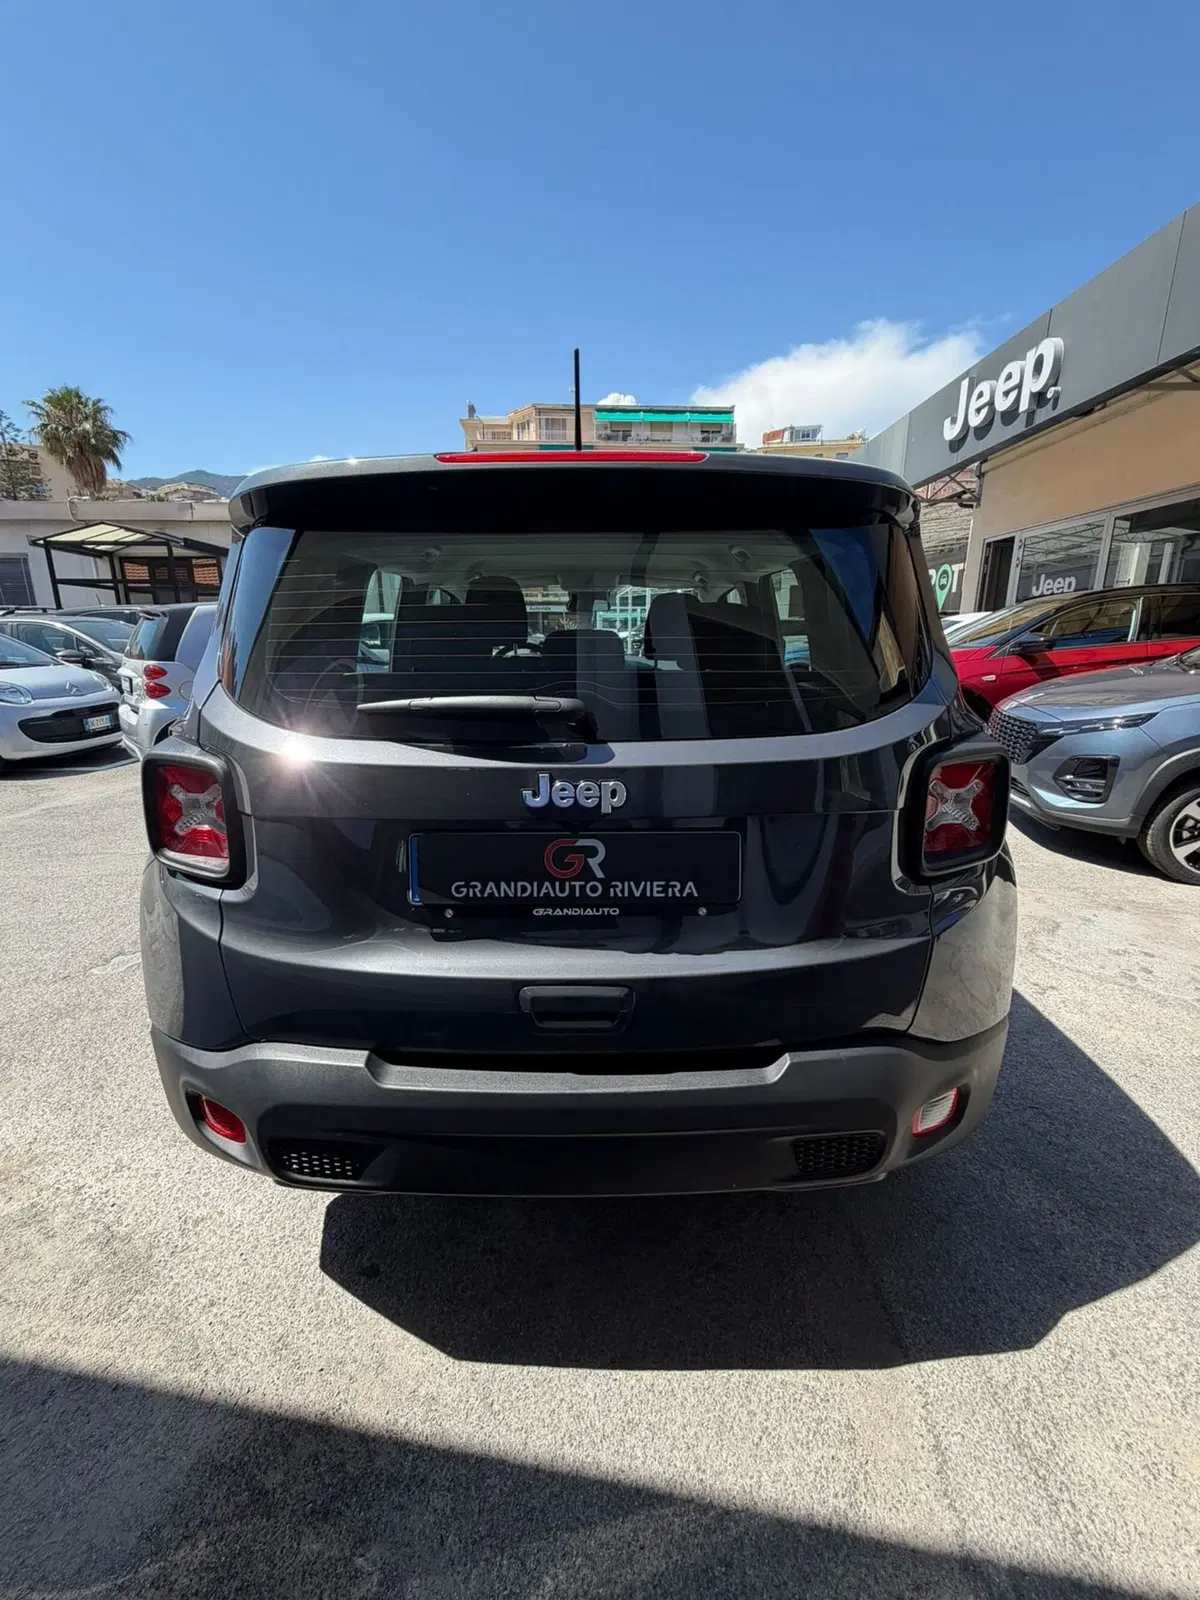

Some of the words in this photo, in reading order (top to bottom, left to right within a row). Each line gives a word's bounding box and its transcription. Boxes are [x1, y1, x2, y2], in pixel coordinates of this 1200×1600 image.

[943, 338, 1063, 441] Jeep
[1032, 573, 1076, 597] Jeep
[521, 772, 627, 814] Jeep
[544, 839, 606, 879] GR
[451, 881, 603, 898] GRANDIAUTO
[610, 881, 699, 898] RIVIERA
[532, 907, 620, 916] GRANDIAUTO
